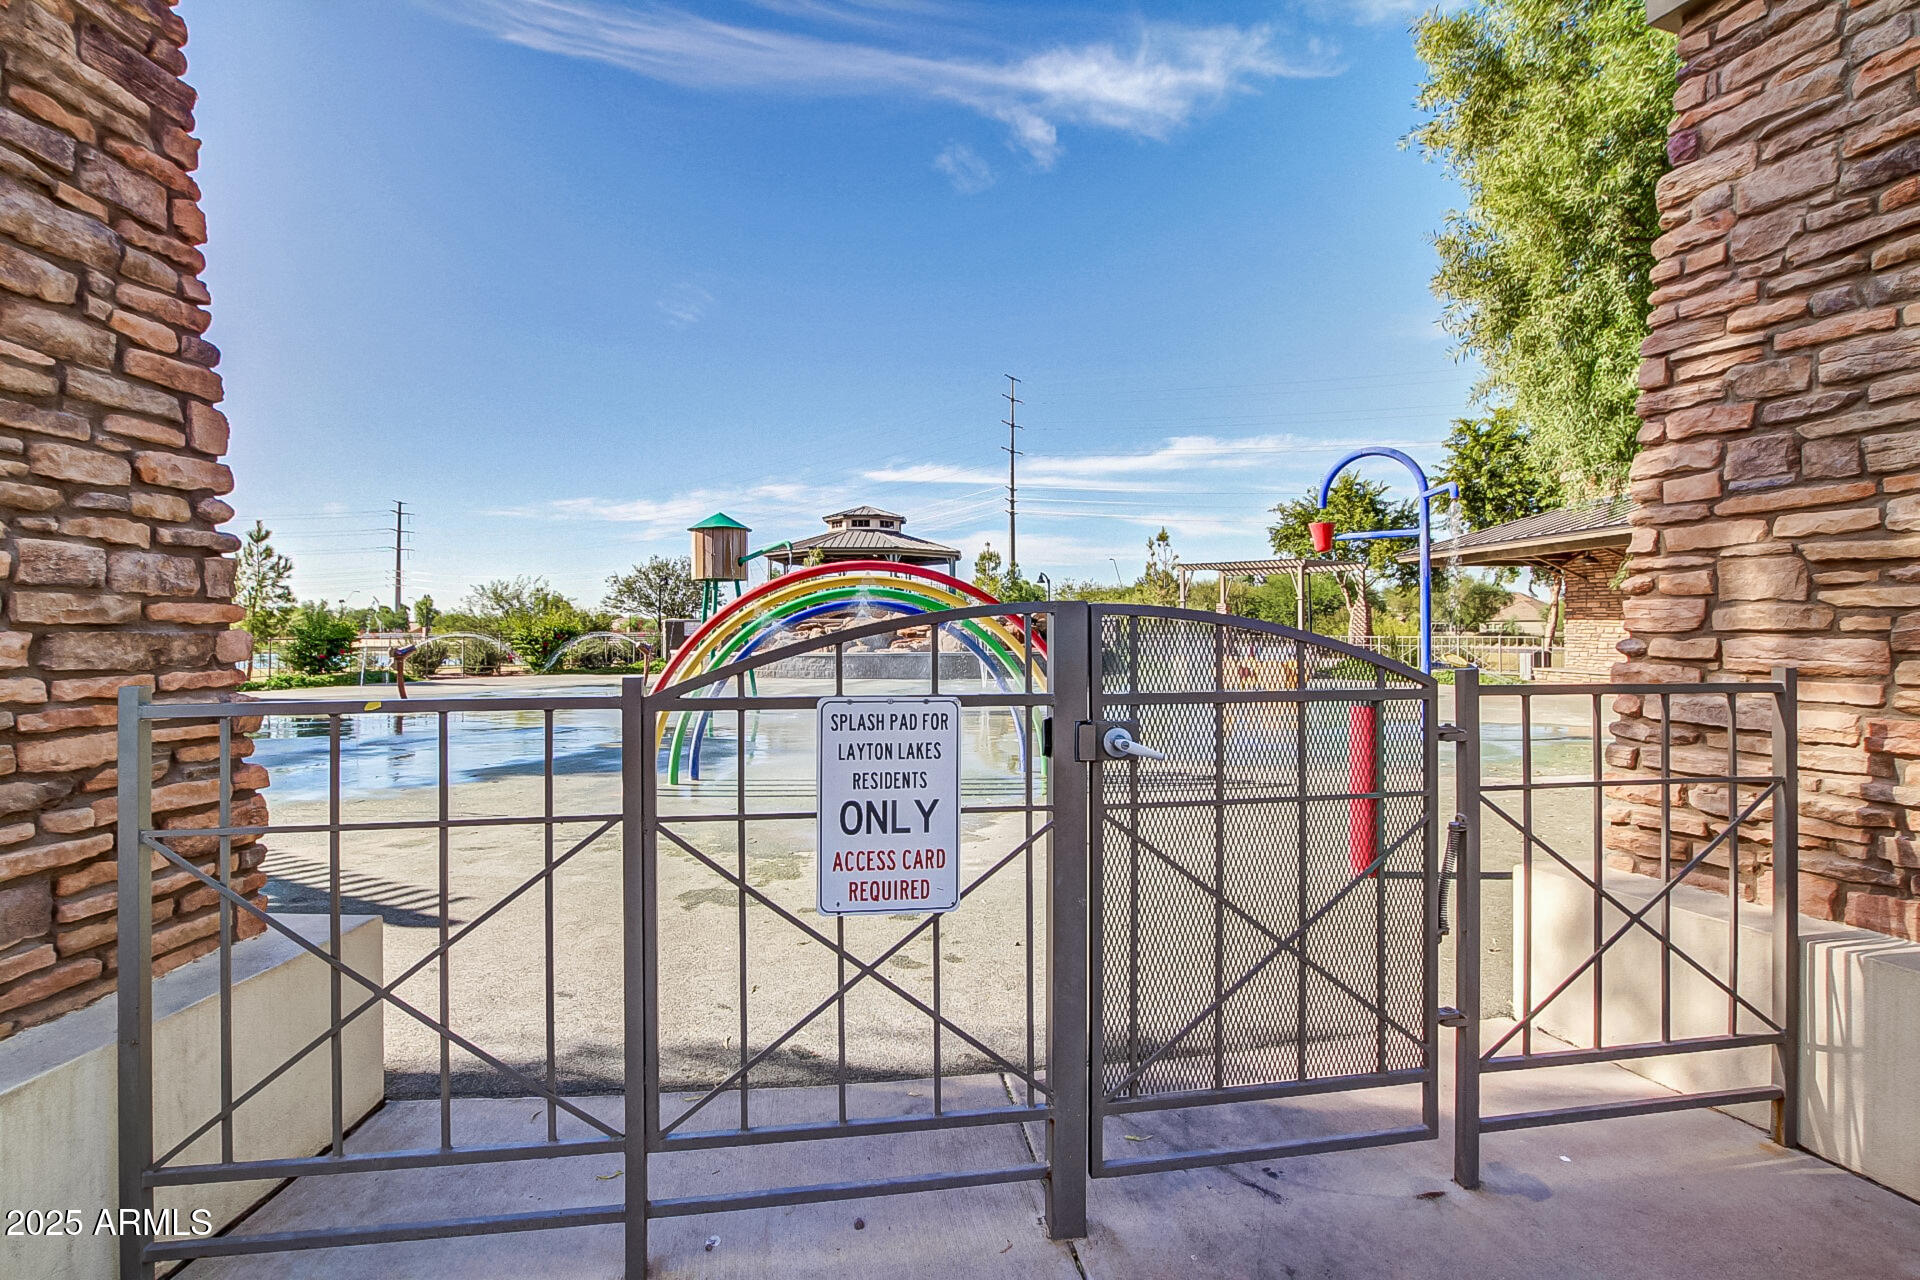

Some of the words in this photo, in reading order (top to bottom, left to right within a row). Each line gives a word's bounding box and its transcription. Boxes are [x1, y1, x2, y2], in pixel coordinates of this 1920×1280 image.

[830, 713, 885, 731] SPLASH
[889, 713, 918, 731] PAD
[922, 713, 949, 731] FOR
[838, 743, 893, 761] LAYTON
[898, 742, 942, 760] LAKES
[852, 771, 928, 790] RESIDENTS
[839, 799, 940, 836] ONLY
[832, 849, 896, 872] ACCESS
[902, 849, 946, 870] CARD
[849, 879, 930, 902] REQUIRED
